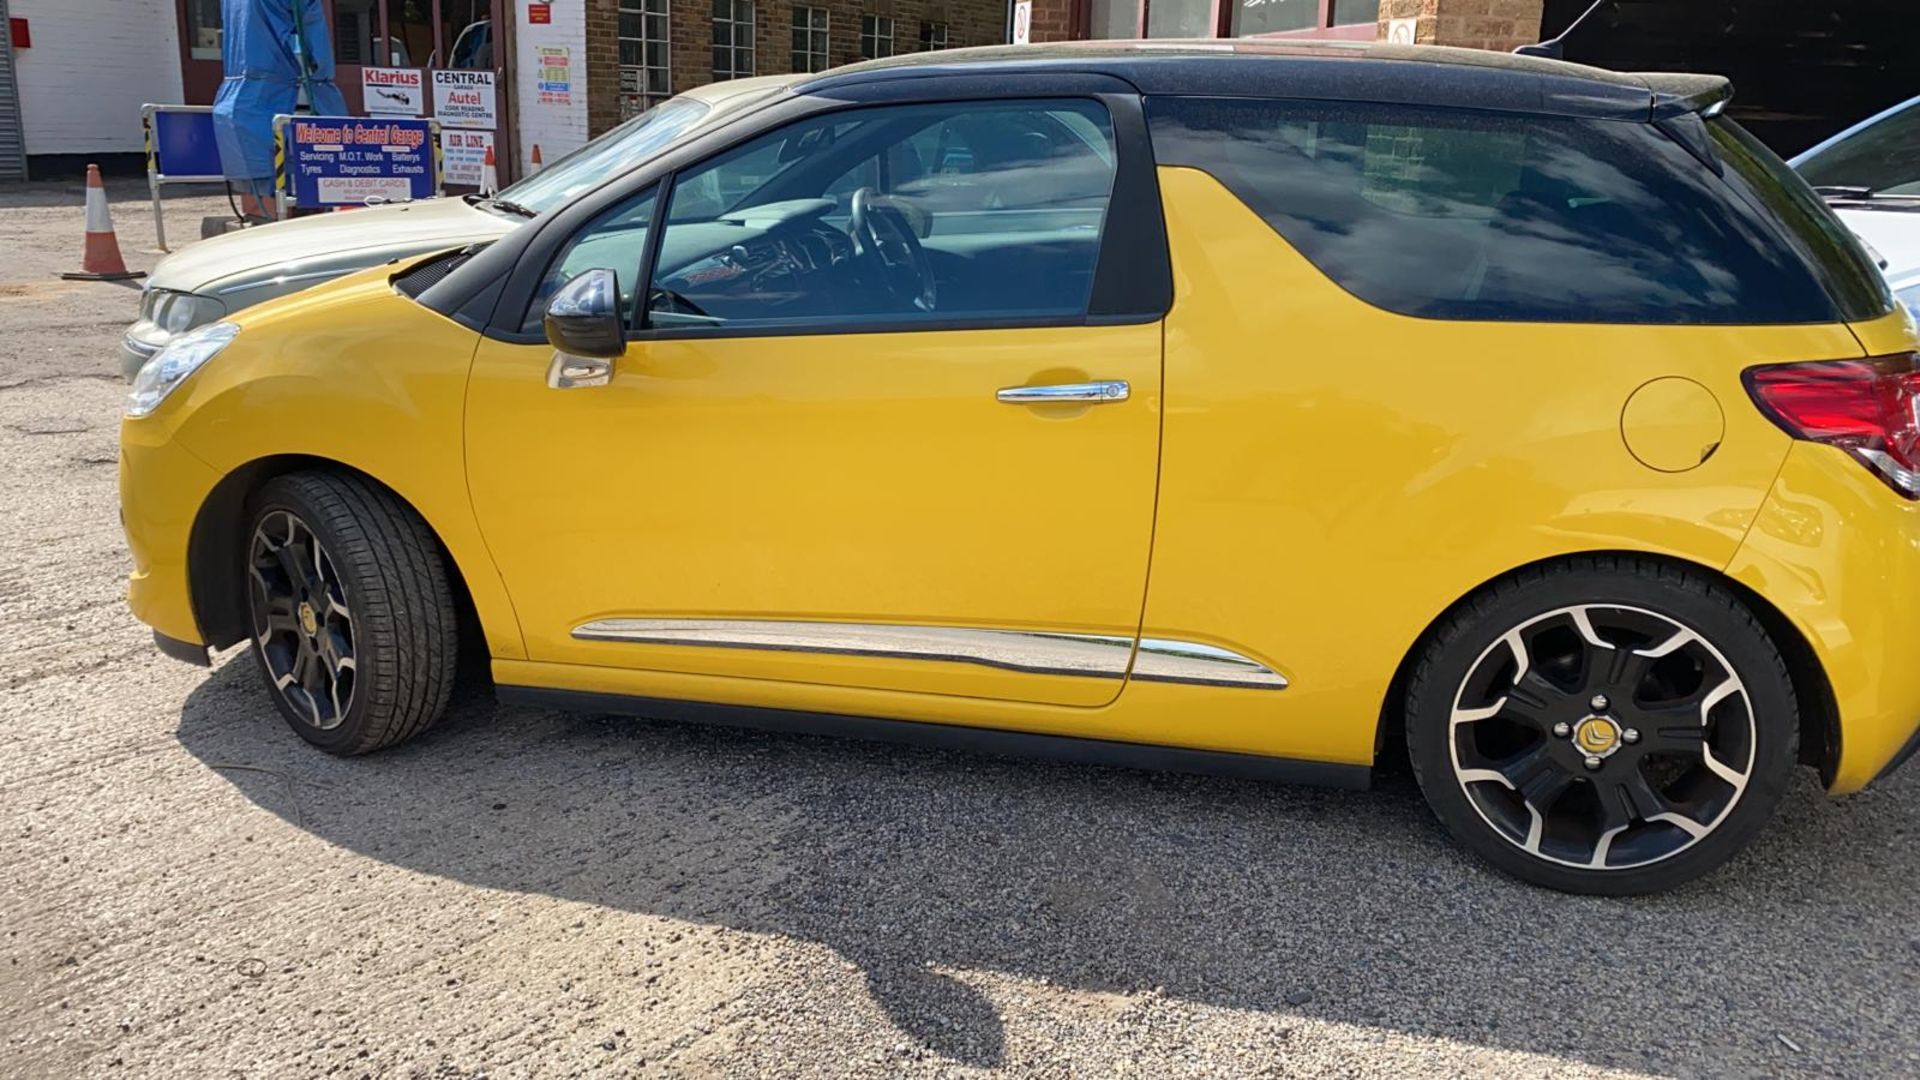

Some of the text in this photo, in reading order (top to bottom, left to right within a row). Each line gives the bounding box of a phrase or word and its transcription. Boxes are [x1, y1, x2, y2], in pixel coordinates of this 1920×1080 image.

[365, 70, 419, 85] Klarius
[436, 72, 492, 85] CENTRAL
[448, 92, 481, 105] Autel
[437, 110, 470, 118] DIAGNOSTIC
[296, 123, 424, 149] Welcome to Central Garage
[448, 134, 484, 148] AIR LINE
[300, 151, 334, 163] Servicing
[365, 152, 384, 161] Work
[301, 164, 322, 175] Tyres
[339, 165, 381, 175] Diagnostics
[392, 165, 424, 174] Exhausts
[323, 179, 347, 188] CASH
[354, 179, 378, 188] DEBIT
[380, 180, 406, 189] CARDS
